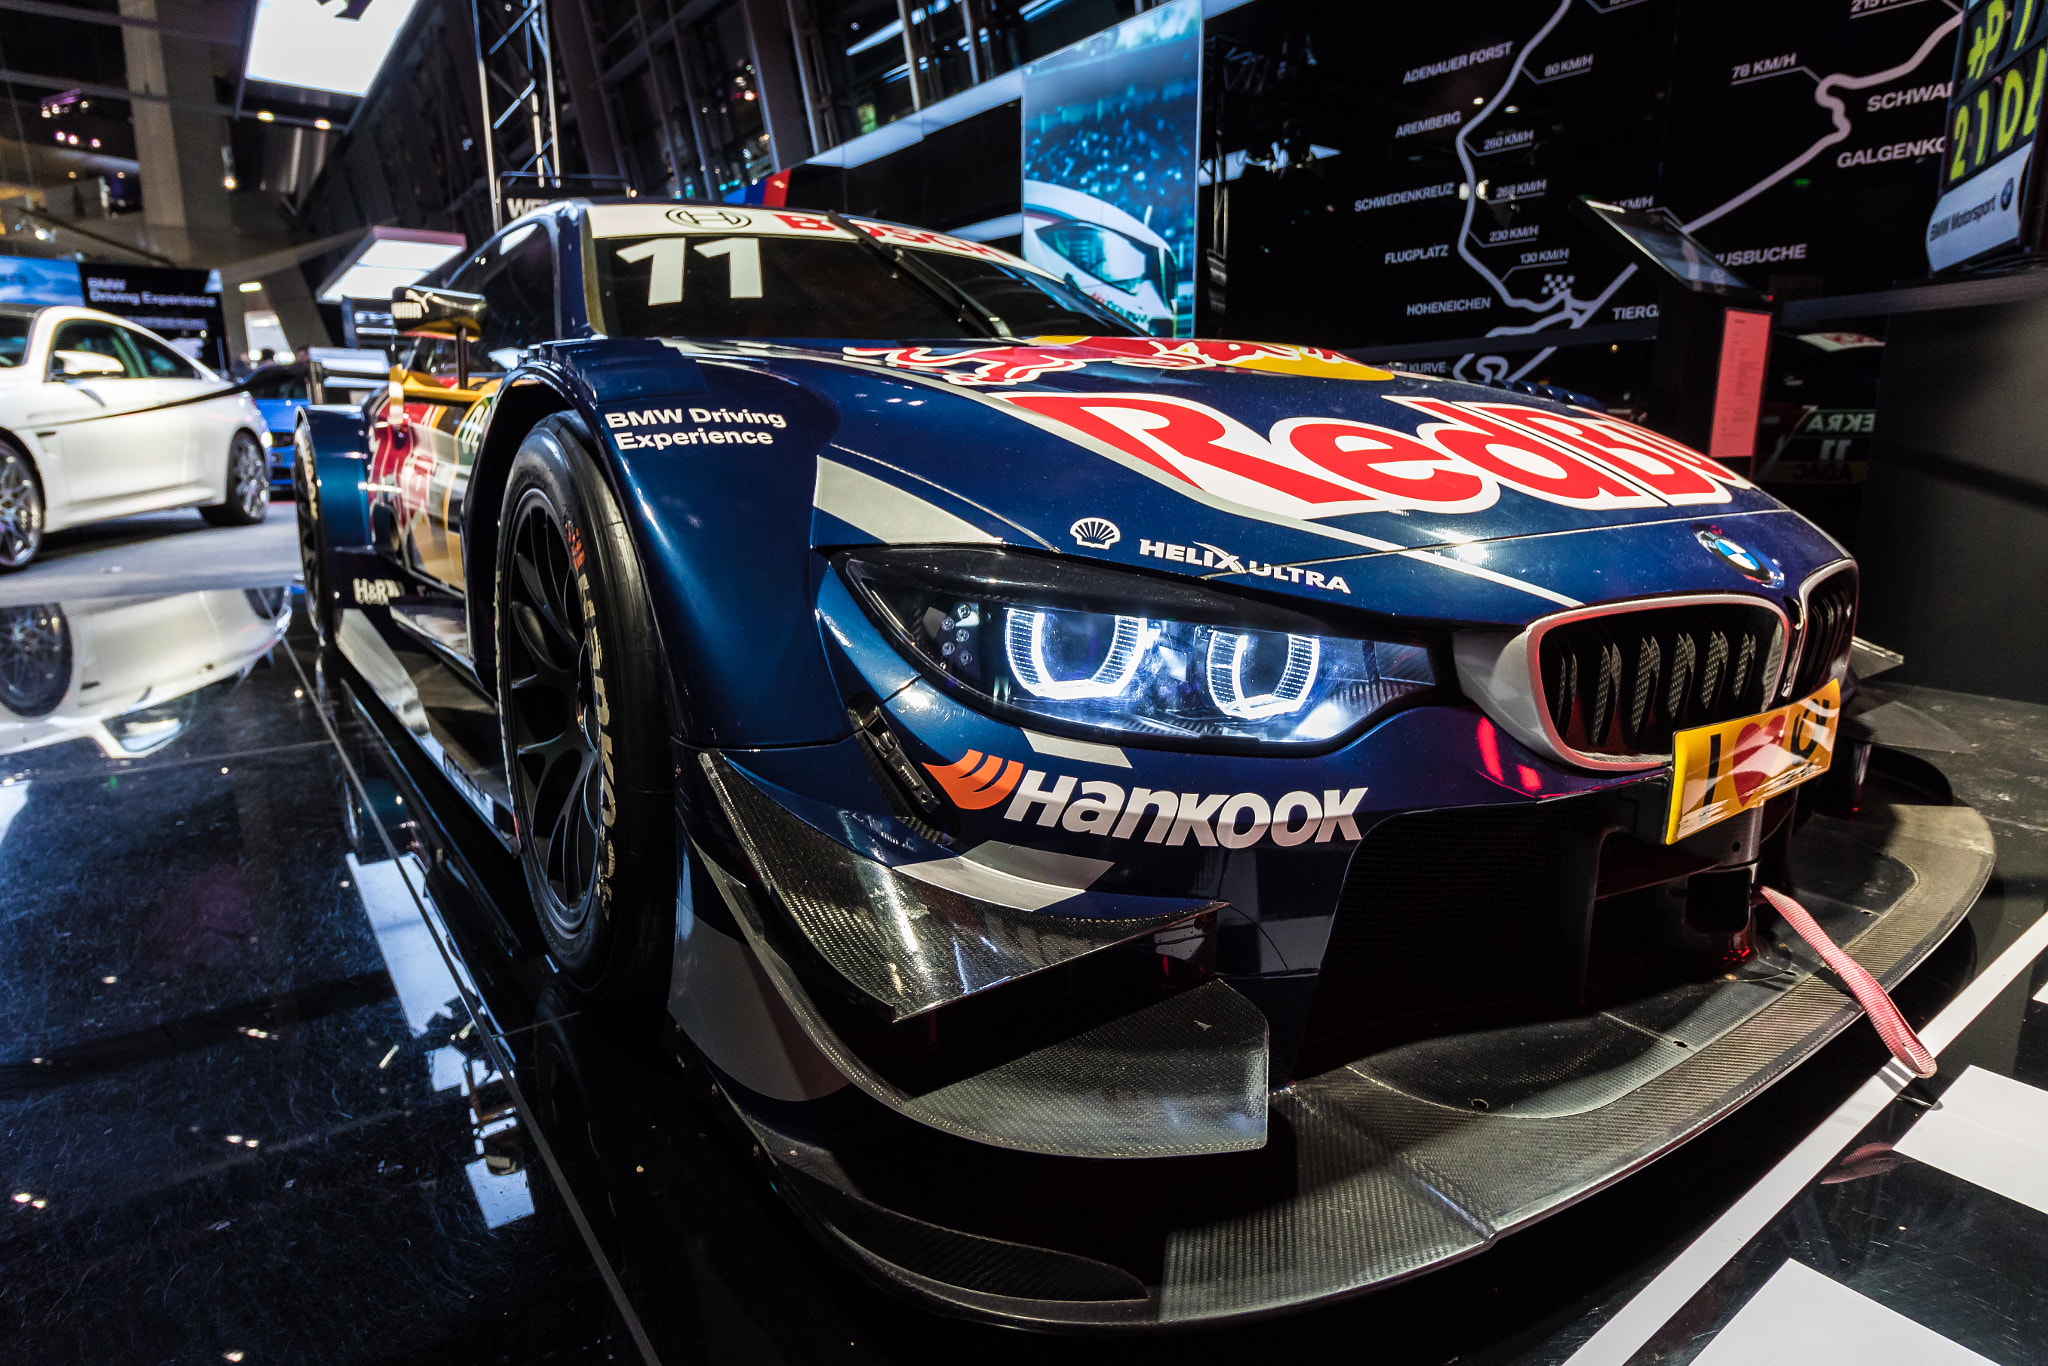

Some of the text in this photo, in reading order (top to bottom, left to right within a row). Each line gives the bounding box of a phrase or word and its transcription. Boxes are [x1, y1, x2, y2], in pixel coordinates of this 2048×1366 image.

[1403, 40, 1514, 84] ADENAUER FORST
[1560, 54, 1594, 74] KM/H
[1732, 52, 1797, 80] 78 KM/H
[1395, 110, 1462, 139] AREMBERG
[1504, 129, 1535, 146] KM/H
[1354, 182, 1455, 212] SCHWEDENKREUZ
[1516, 179, 1547, 195] KM/H
[1951, 194, 1998, 232] Motorsport
[1509, 225, 1540, 240] KM/H
[1384, 244, 1449, 264] FLUGPLATZ
[1538, 247, 1570, 262] KM/H
[1716, 243, 1808, 267] USBUCHE
[616, 237, 764, 306] 11
[1406, 297, 1492, 316] HOHENEICHEN
[1612, 303, 1660, 321] TIERG
[1409, 361, 1447, 374] KURVE
[604, 407, 787, 429] BMW Driving
[613, 427, 774, 451] Experience
[1003, 392, 1668, 519] Red
[1139, 539, 1352, 595] HELIX ULTRA
